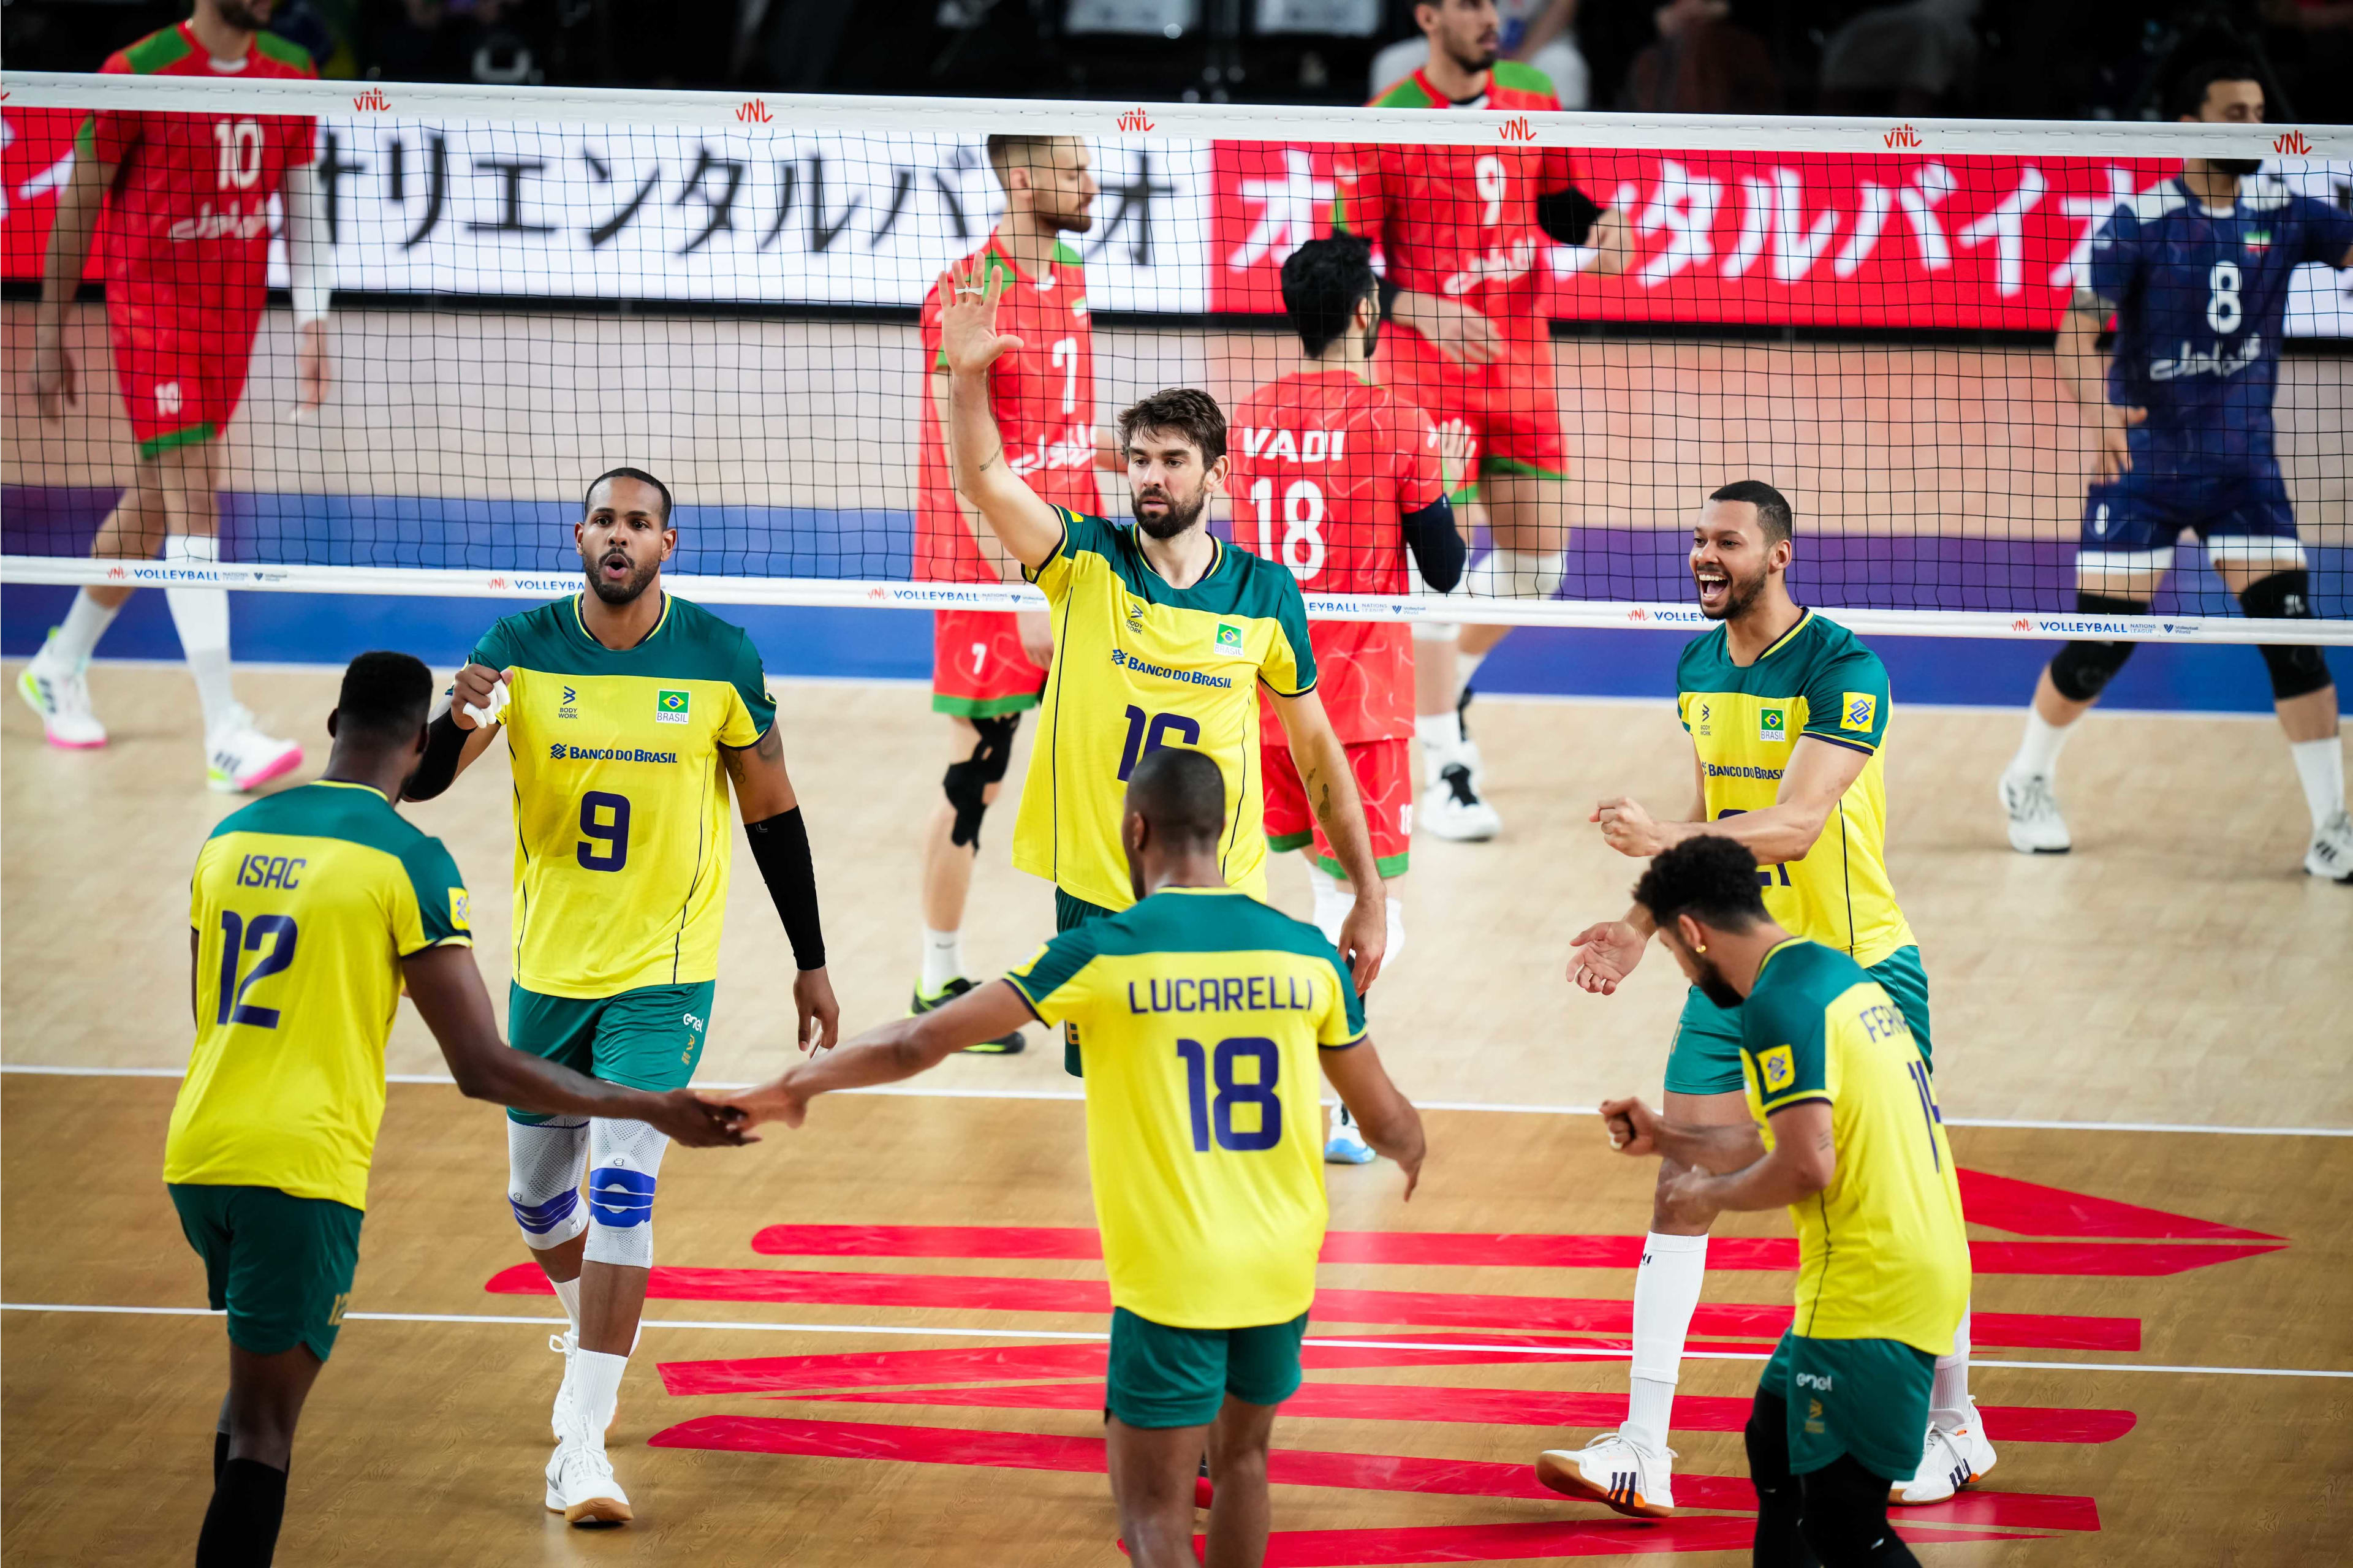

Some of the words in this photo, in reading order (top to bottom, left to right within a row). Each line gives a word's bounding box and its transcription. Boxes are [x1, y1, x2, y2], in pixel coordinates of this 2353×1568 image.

[354, 88, 391, 112] VNL
[736, 98, 773, 123] VNL
[1117, 107, 1155, 132] VNL
[1498, 116, 1536, 141] VNL
[1884, 124, 1922, 148] VNL
[2273, 130, 2312, 155] VNL
[214, 120, 264, 191] 10
[1476, 156, 1507, 226] 9
[2207, 260, 2242, 333] 8
[1052, 338, 1077, 414] 7
[154, 381, 182, 415] 10
[1243, 427, 1346, 463] VADI
[1251, 477, 1325, 580] 18
[134, 569, 219, 581] VOLLEYBALL
[515, 580, 584, 591] VOLLEYBA
[894, 590, 979, 601] VOLLEYBALL
[1306, 602, 1359, 612] EYBALL
[1126, 619, 1143, 628] BODY
[1627, 608, 1649, 621] VNL
[2012, 618, 2033, 632] VNL
[2040, 621, 2128, 633] VOLLEYBALL
[971, 642, 987, 675] 7
[1214, 643, 1243, 656] BRASIL
[1127, 657, 1172, 678] BANCO
[1172, 670, 1190, 682] DO
[1192, 671, 1232, 688] BRASIL
[657, 712, 688, 723] BRASIL
[1761, 730, 1785, 740] BRASIL
[570, 746, 613, 760] BANCO
[615, 749, 632, 761] DO
[634, 749, 678, 763] BRASIL
[1708, 764, 1741, 777] BANCO
[1743, 767, 1754, 778] DO
[1754, 766, 1785, 780] BRASI
[577, 790, 631, 872] 9
[237, 854, 306, 890] ISAC
[218, 910, 298, 1029] 12
[1128, 976, 1313, 1015] LUCARELLI
[683, 1013, 704, 1033] enel
[1176, 1037, 1282, 1152] 18
[1796, 1372, 1833, 1392] enel
